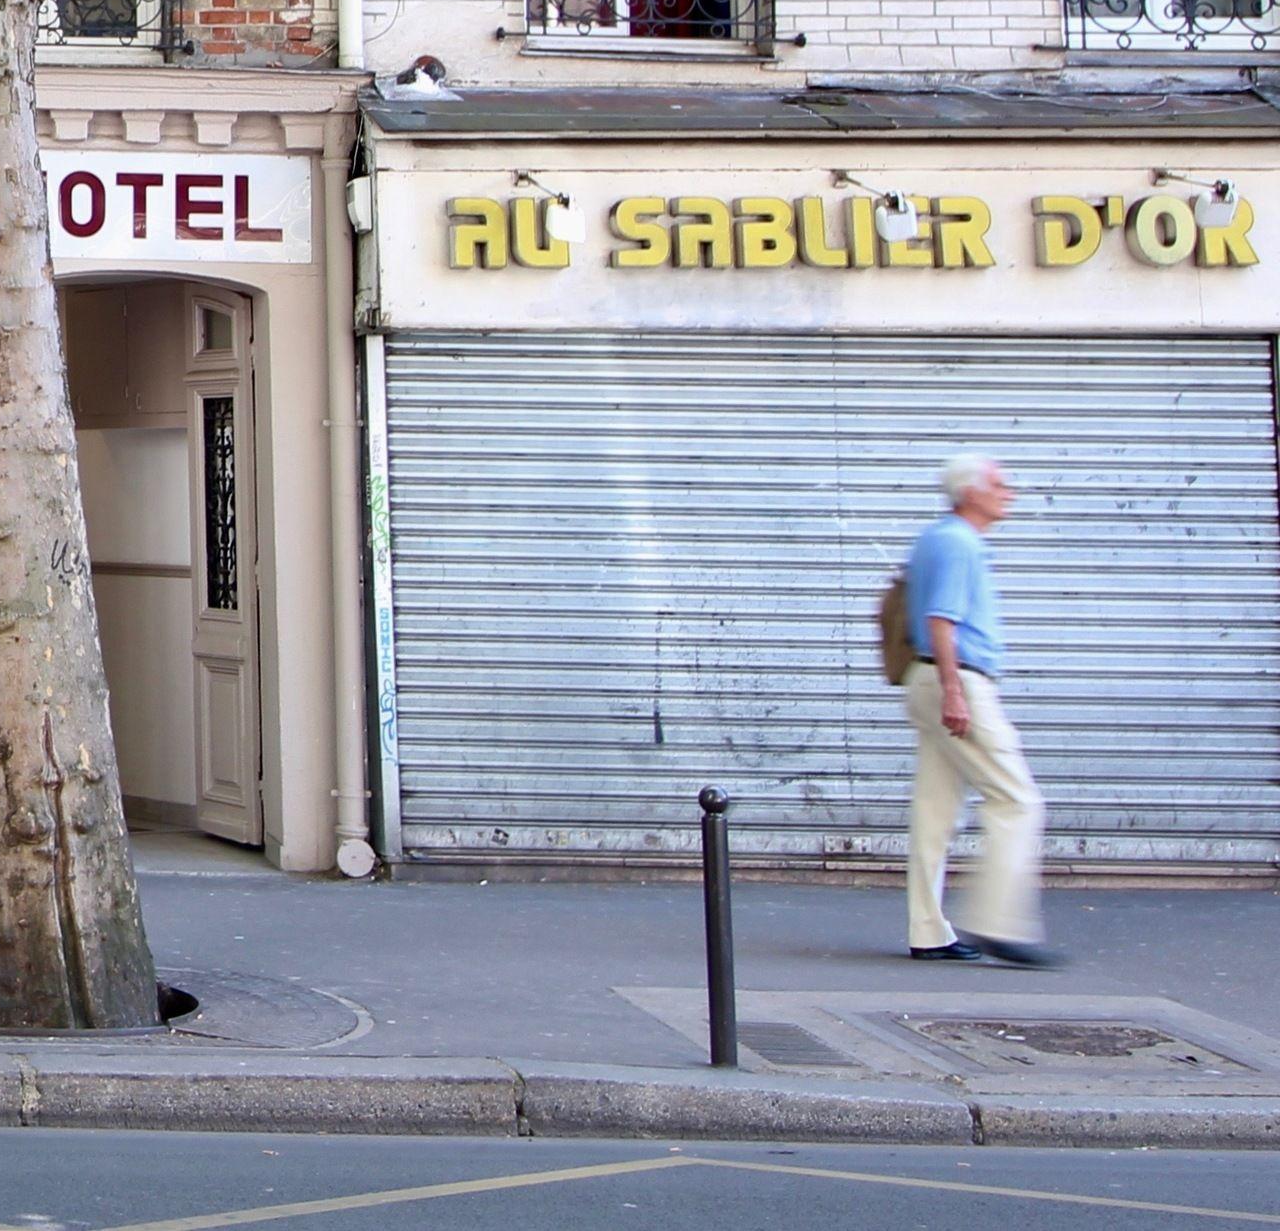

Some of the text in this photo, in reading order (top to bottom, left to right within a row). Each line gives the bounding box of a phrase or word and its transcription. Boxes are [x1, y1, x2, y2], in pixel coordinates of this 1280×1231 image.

[42, 170, 283, 242] OTEL
[446, 195, 1261, 268] AU SABLIER D'OR
